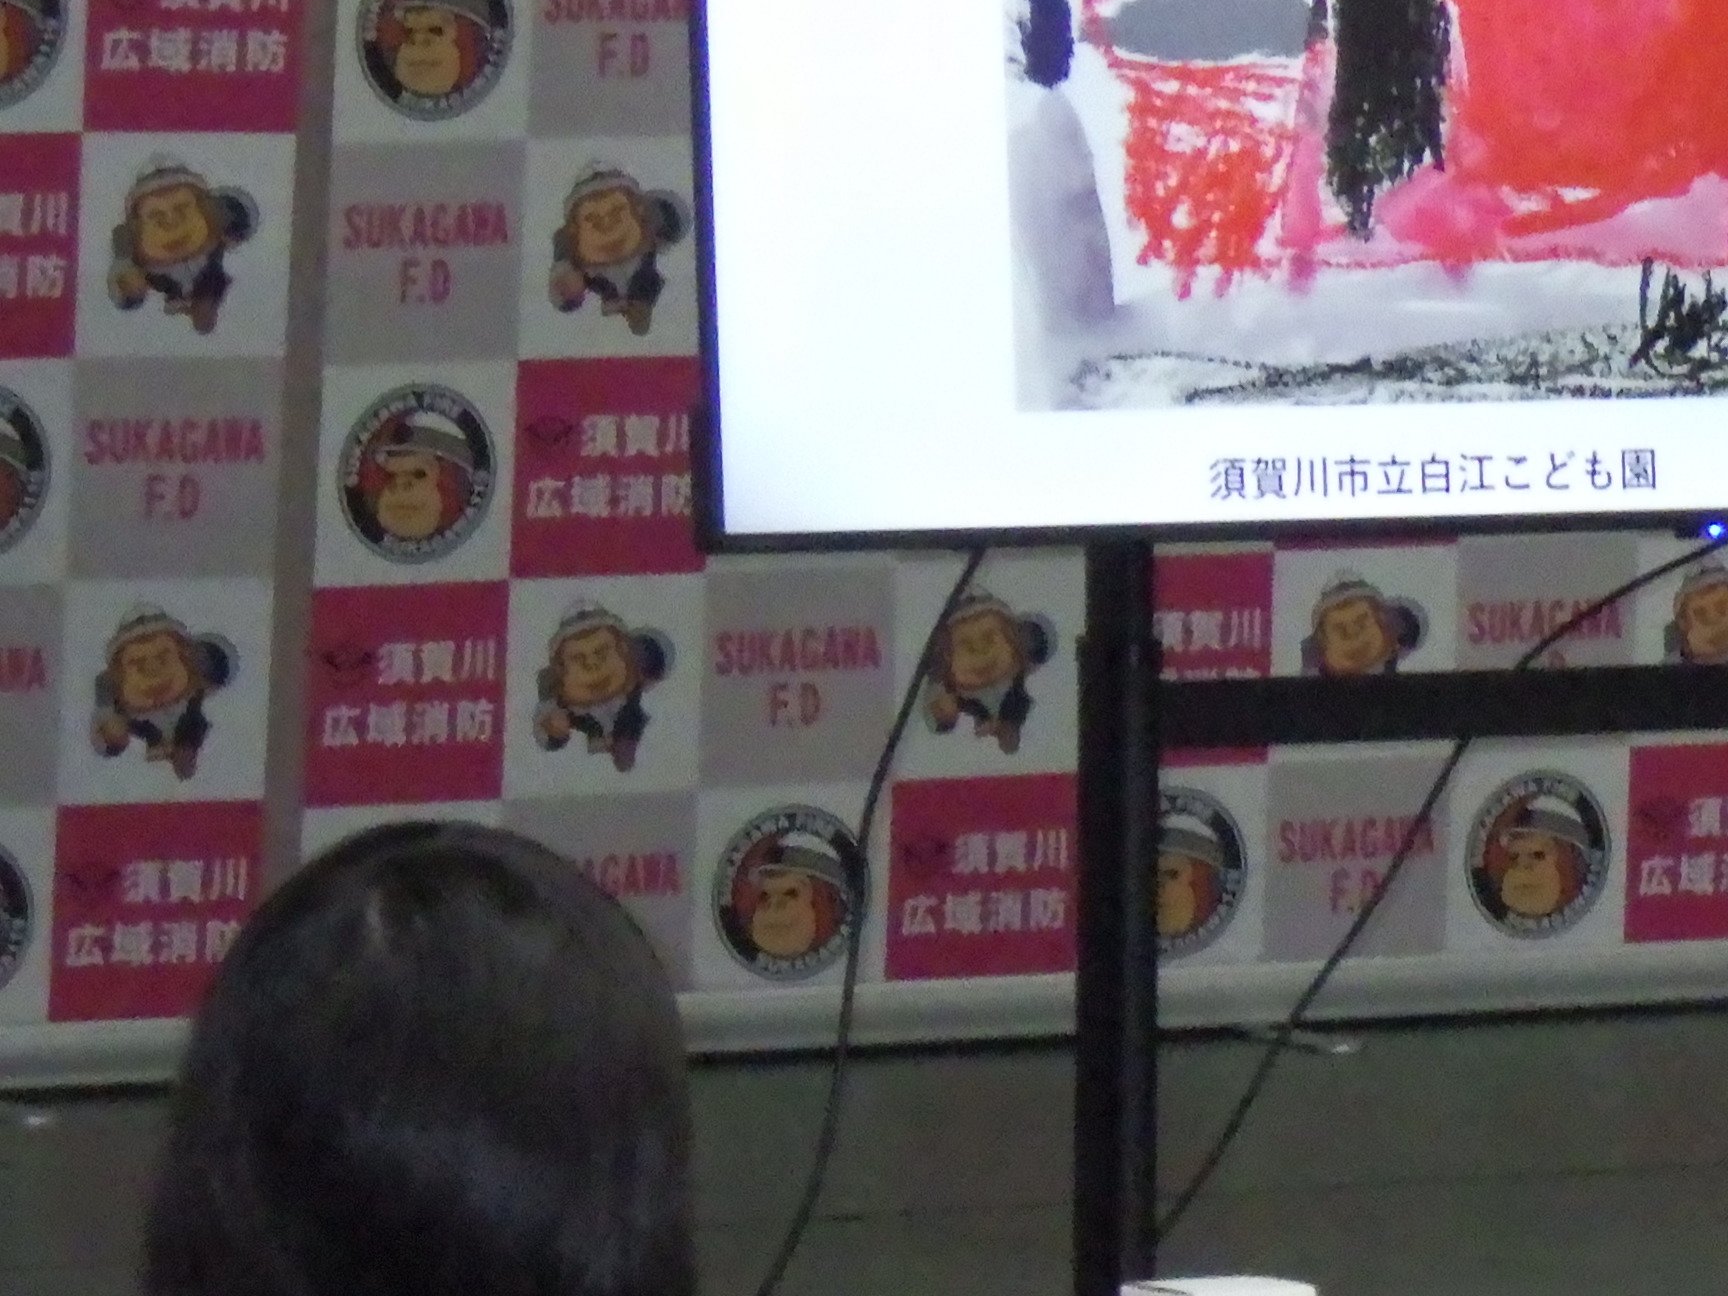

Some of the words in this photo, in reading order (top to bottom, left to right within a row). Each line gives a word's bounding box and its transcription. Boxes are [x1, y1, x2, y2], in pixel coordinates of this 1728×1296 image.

[101, 27, 288, 73] 広域消防
[344, 204, 508, 249] SUKAGAWA
[86, 418, 264, 465] SUKAGAWA
[1210, 448, 1656, 500] 須賀川市立白江こども園
[378, 638, 497, 684] 須賀川
[714, 627, 883, 676] SUKAGAWA
[324, 700, 494, 747] 広域消防
[955, 830, 1069, 874] 須賀川
[121, 858, 249, 904] 須賀川
[902, 888, 1066, 935] 広域消防
